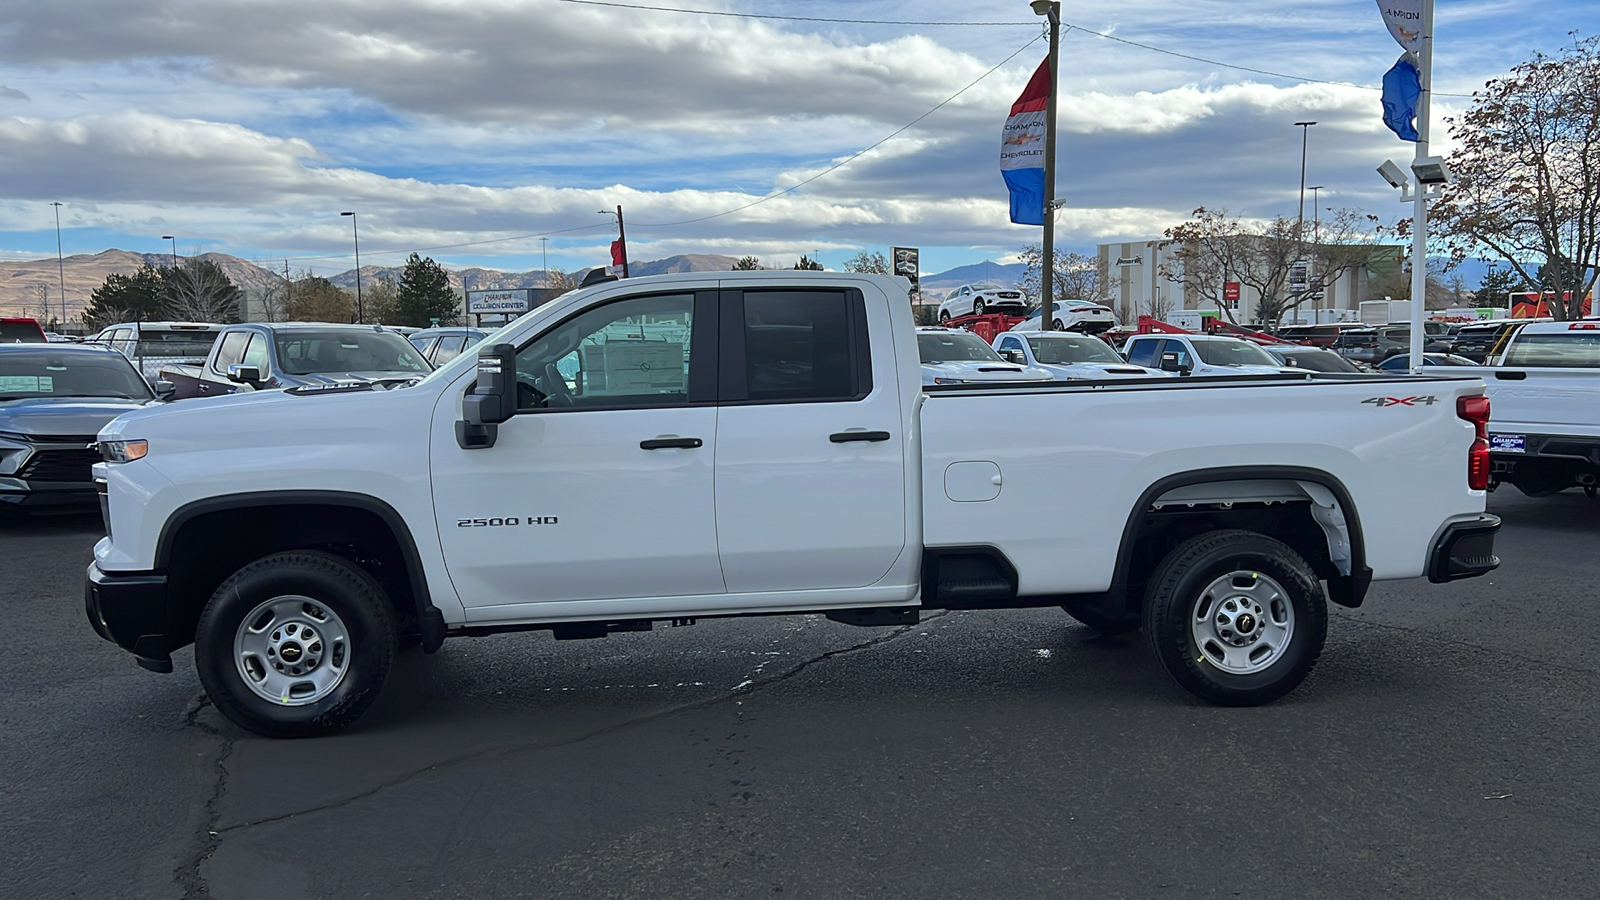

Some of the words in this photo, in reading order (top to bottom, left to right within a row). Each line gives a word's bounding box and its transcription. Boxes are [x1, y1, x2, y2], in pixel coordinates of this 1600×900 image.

[1001, 149, 1044, 159] CHEVROLET
[484, 293, 513, 303] CHAMPION
[1492, 436, 1524, 448] CHAMPION
[457, 517, 520, 528] 2500
[526, 516, 559, 526] HD
